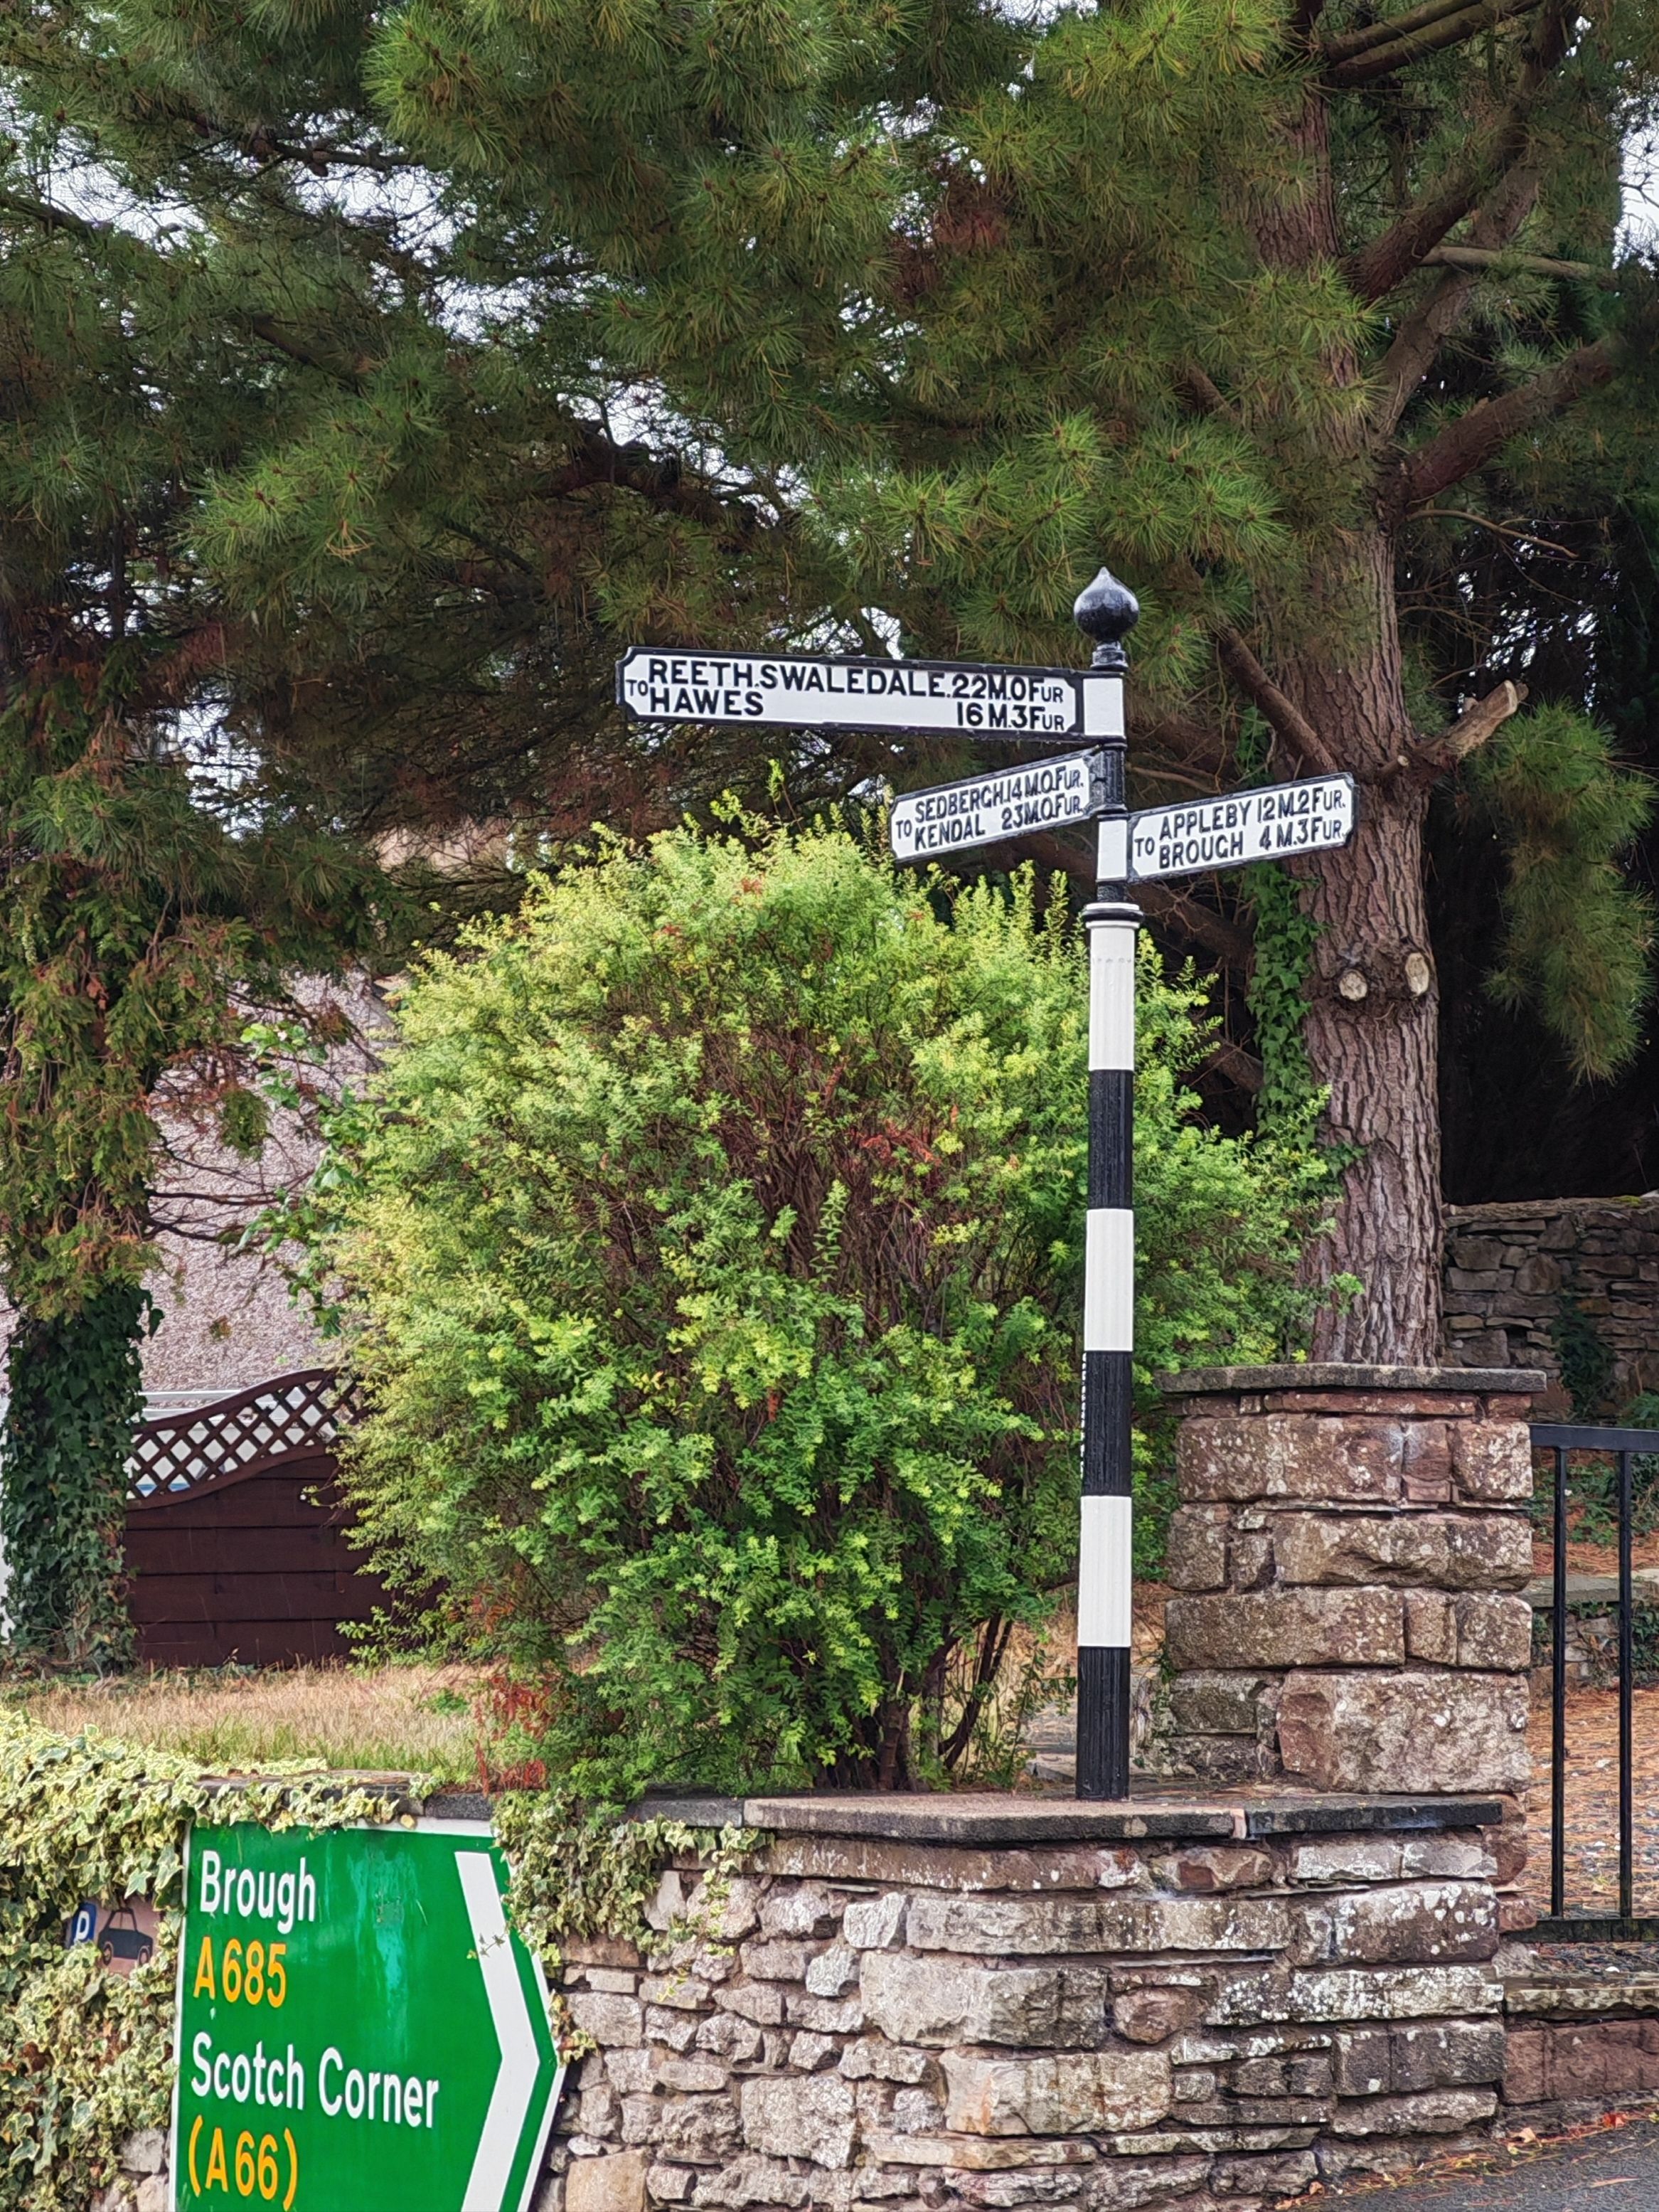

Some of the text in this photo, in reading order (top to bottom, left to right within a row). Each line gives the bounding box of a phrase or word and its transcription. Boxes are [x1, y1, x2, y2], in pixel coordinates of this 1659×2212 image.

[625, 679, 649, 696] TO
[649, 686, 764, 716] HAWES
[895, 819, 912, 839] TO
[914, 814, 986, 851] KENDAL
[1159, 799, 1252, 841] APPLEBY
[1134, 836, 1155, 857] TO
[1159, 830, 1244, 869] BROUGH
[200, 1849, 316, 1935] Brough
[193, 1936, 287, 2009] A685
[191, 2031, 439, 2129] Scotch Corner
